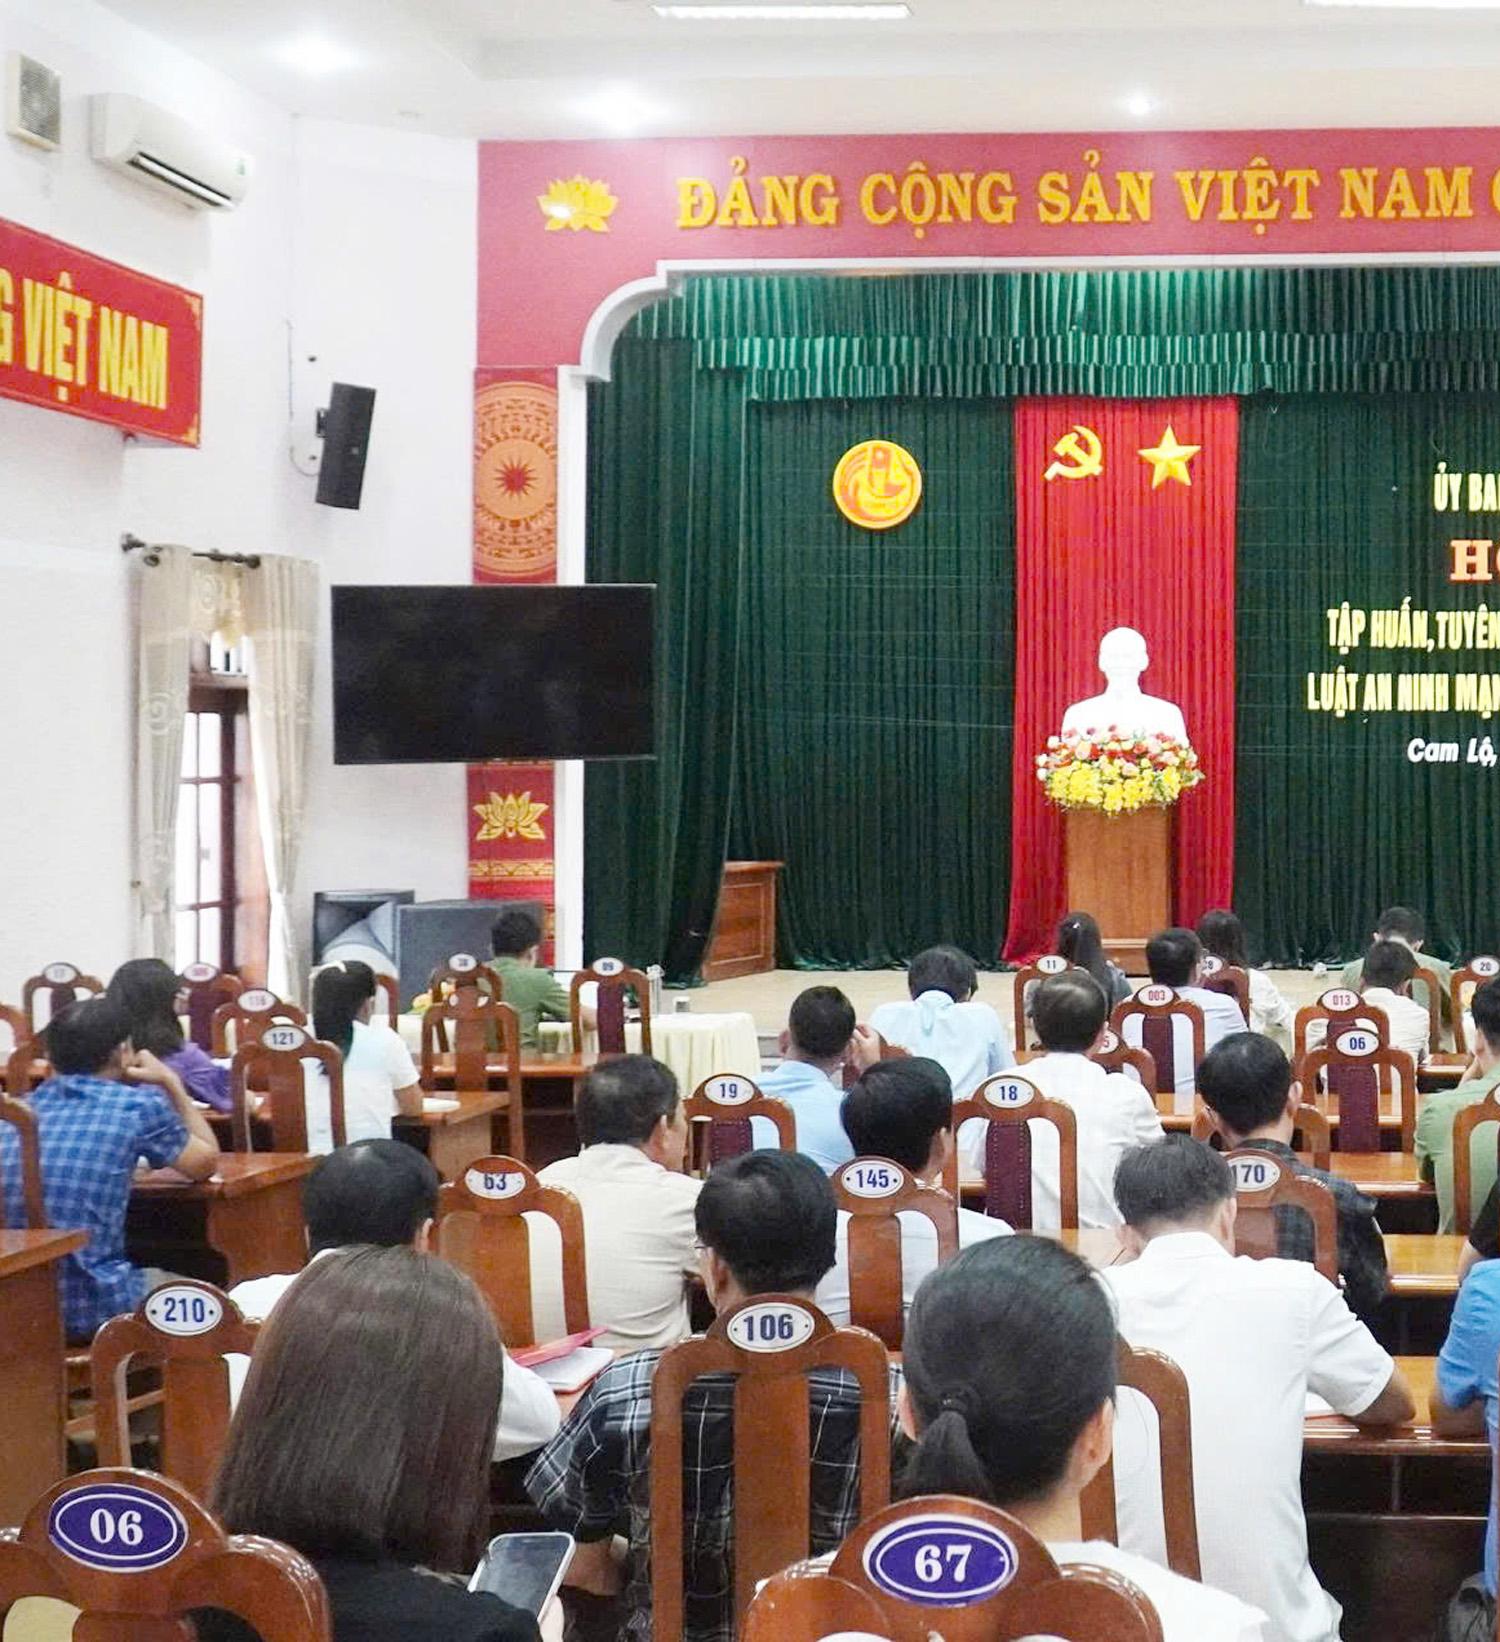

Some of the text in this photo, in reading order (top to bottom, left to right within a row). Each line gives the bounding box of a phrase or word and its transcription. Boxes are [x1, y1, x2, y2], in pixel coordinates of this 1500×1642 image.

[679, 159, 839, 229] ĐẢNG
[859, 168, 1020, 238] CỘNG
[1039, 152, 1152, 224] SẢN
[1175, 157, 1320, 231] VIỆT
[1341, 167, 1471, 219] NAM
[23, 271, 92, 402] VIỆT
[99, 305, 169, 410] NAM
[1327, 601, 1366, 655] TẬP
[1307, 665, 1358, 718] LUẬT
[1363, 673, 1392, 711] AN
[1397, 673, 1449, 711] NINH
[1407, 738, 1459, 763] Cam
[1148, 990, 1166, 1001] 003
[1333, 994, 1351, 1006] 013
[272, 1032, 294, 1045] 121
[1349, 1037, 1366, 1050] 06
[720, 1084, 738, 1098] 19
[1000, 1086, 1018, 1100] 18
[856, 1170, 888, 1188] 145
[165, 1297, 204, 1322] 210
[744, 1314, 793, 1341] 106
[90, 1509, 143, 1545] 06
[915, 1544, 971, 1582] 67
